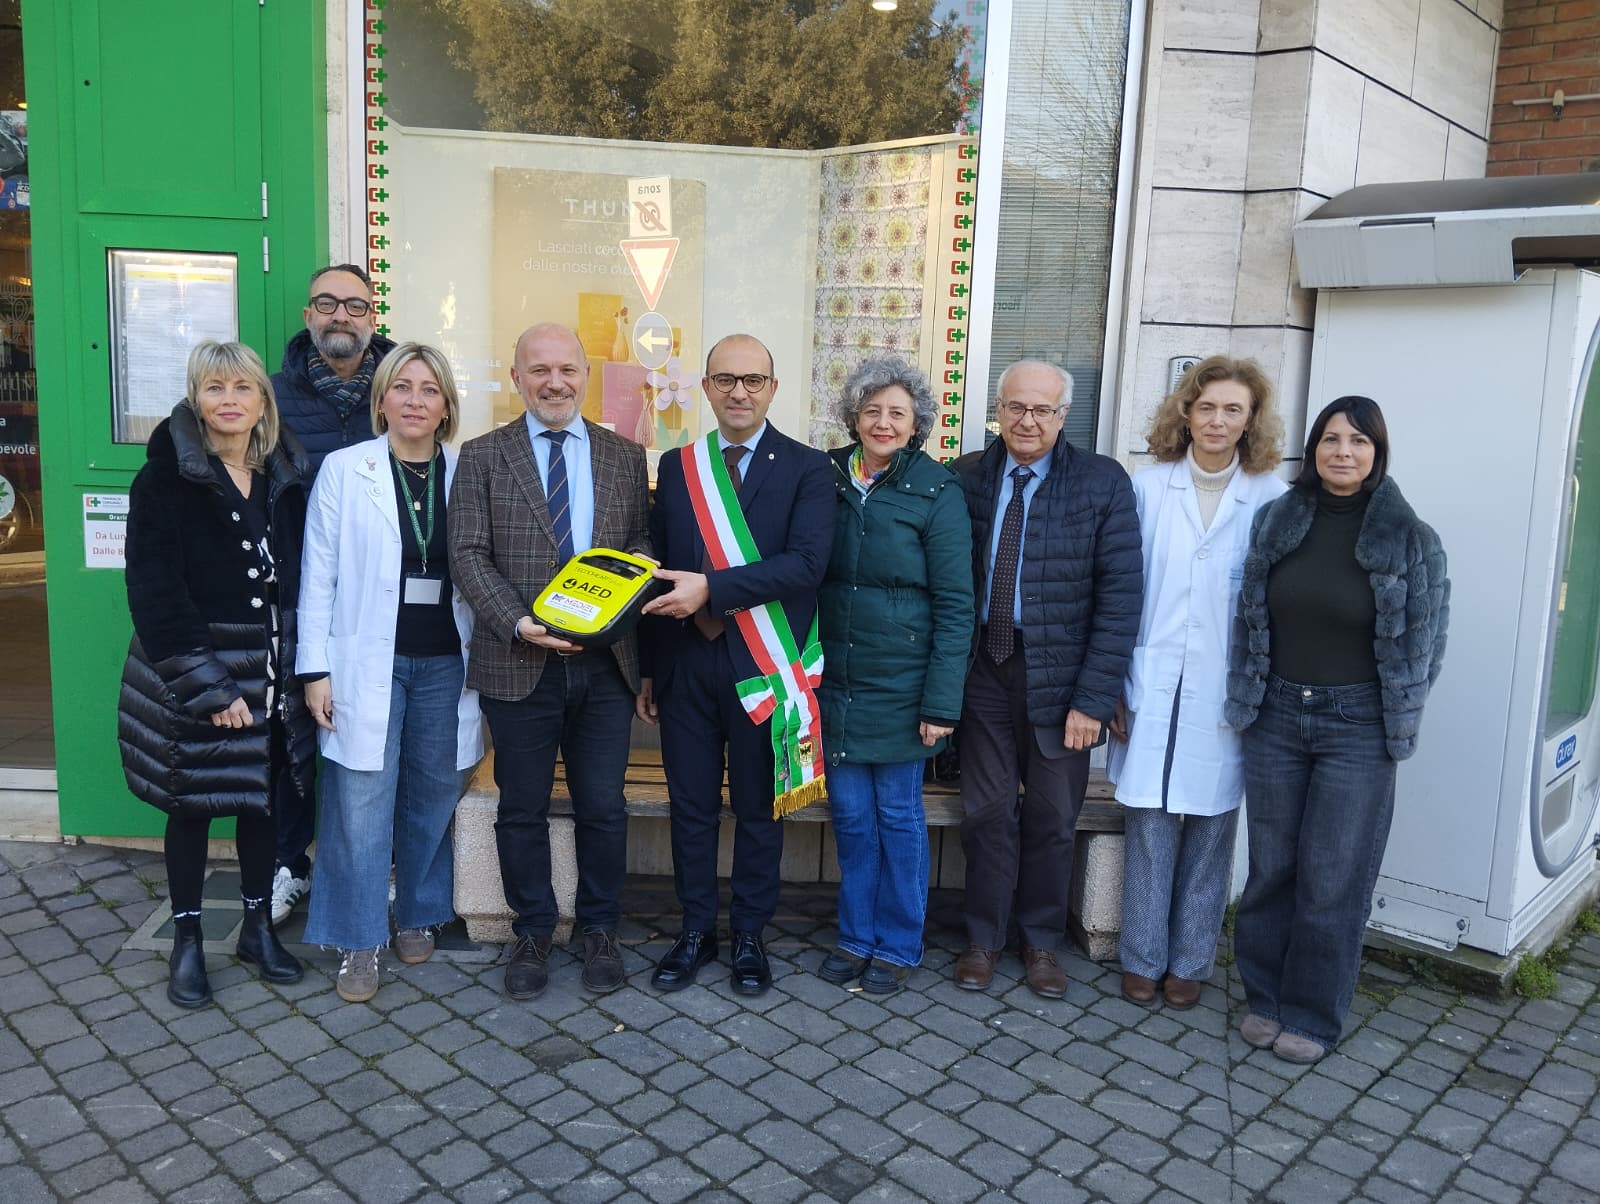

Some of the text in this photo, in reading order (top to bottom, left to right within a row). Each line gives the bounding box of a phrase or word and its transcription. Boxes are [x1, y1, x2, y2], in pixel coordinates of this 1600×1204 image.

[538, 239, 592, 255] Lasciati
[522, 257, 558, 272] dalle
[562, 260, 607, 273] nostre
[96, 532, 106, 540] Da
[92, 547, 116, 555] Dalle
[577, 582, 612, 599] AED
